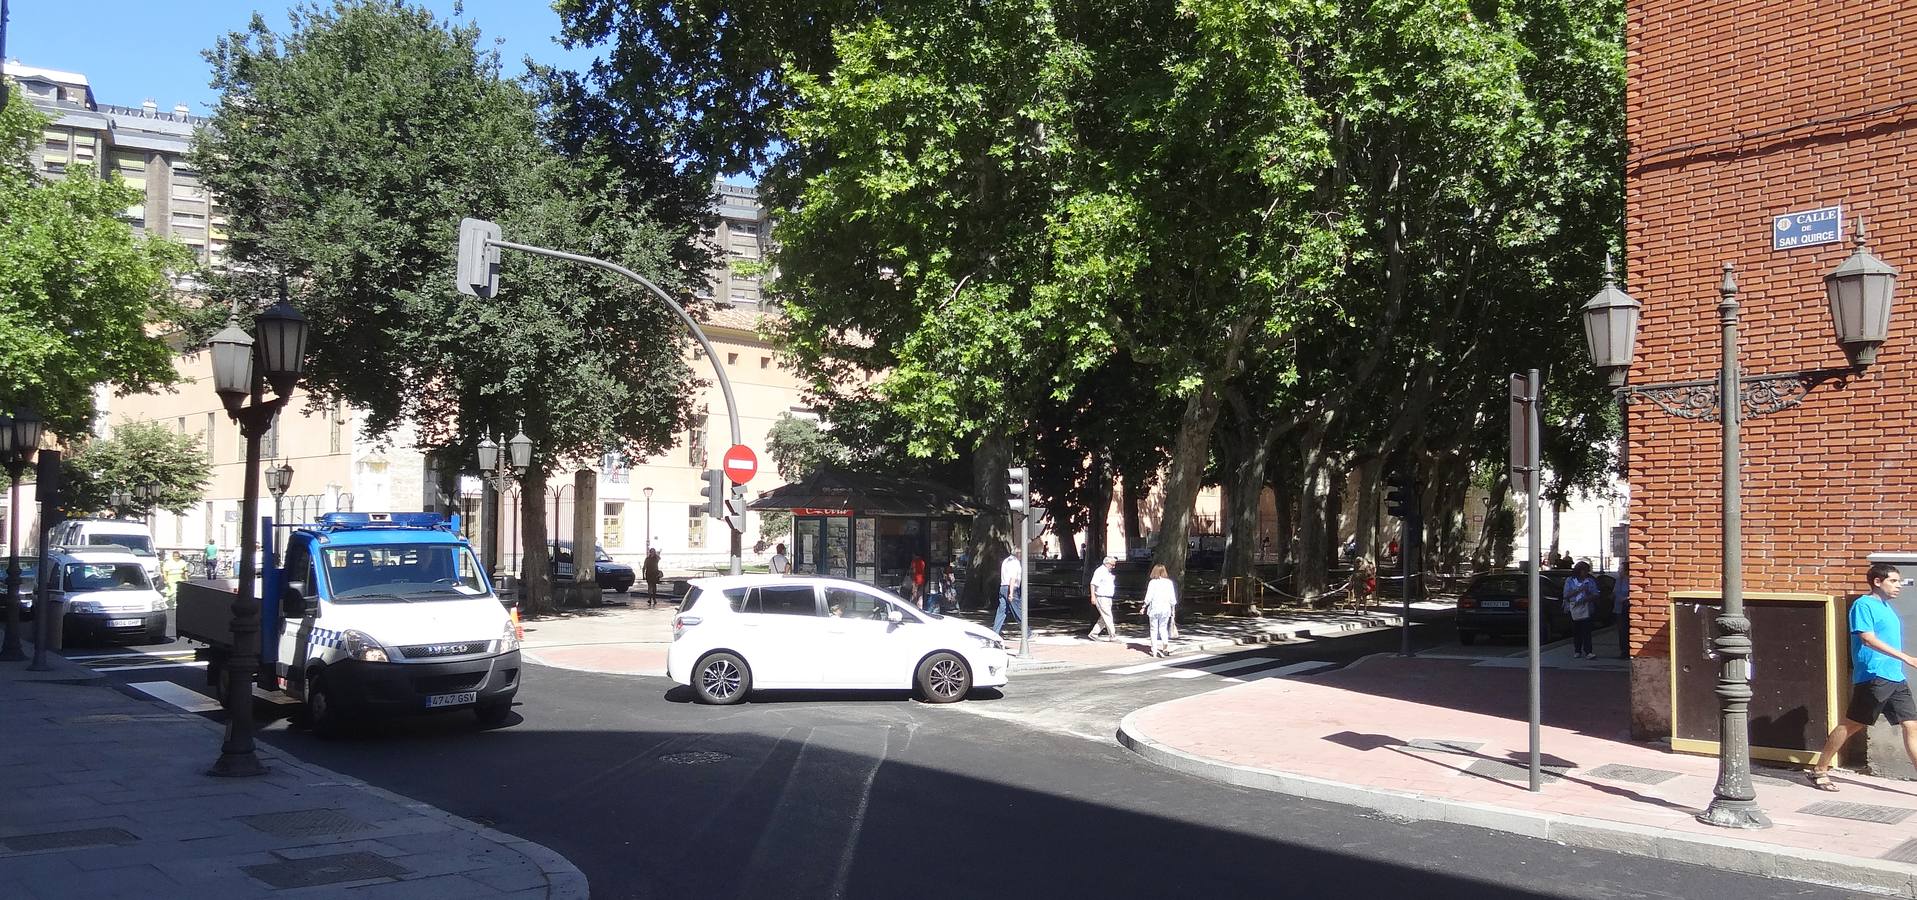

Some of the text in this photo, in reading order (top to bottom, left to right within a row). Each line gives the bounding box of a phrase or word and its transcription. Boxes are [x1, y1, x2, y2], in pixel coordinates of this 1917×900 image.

[1796, 210, 1836, 224] CALLE
[1780, 231, 1834, 246] SAN QUIRCE
[432, 693, 475, 705] 4747 GSV
